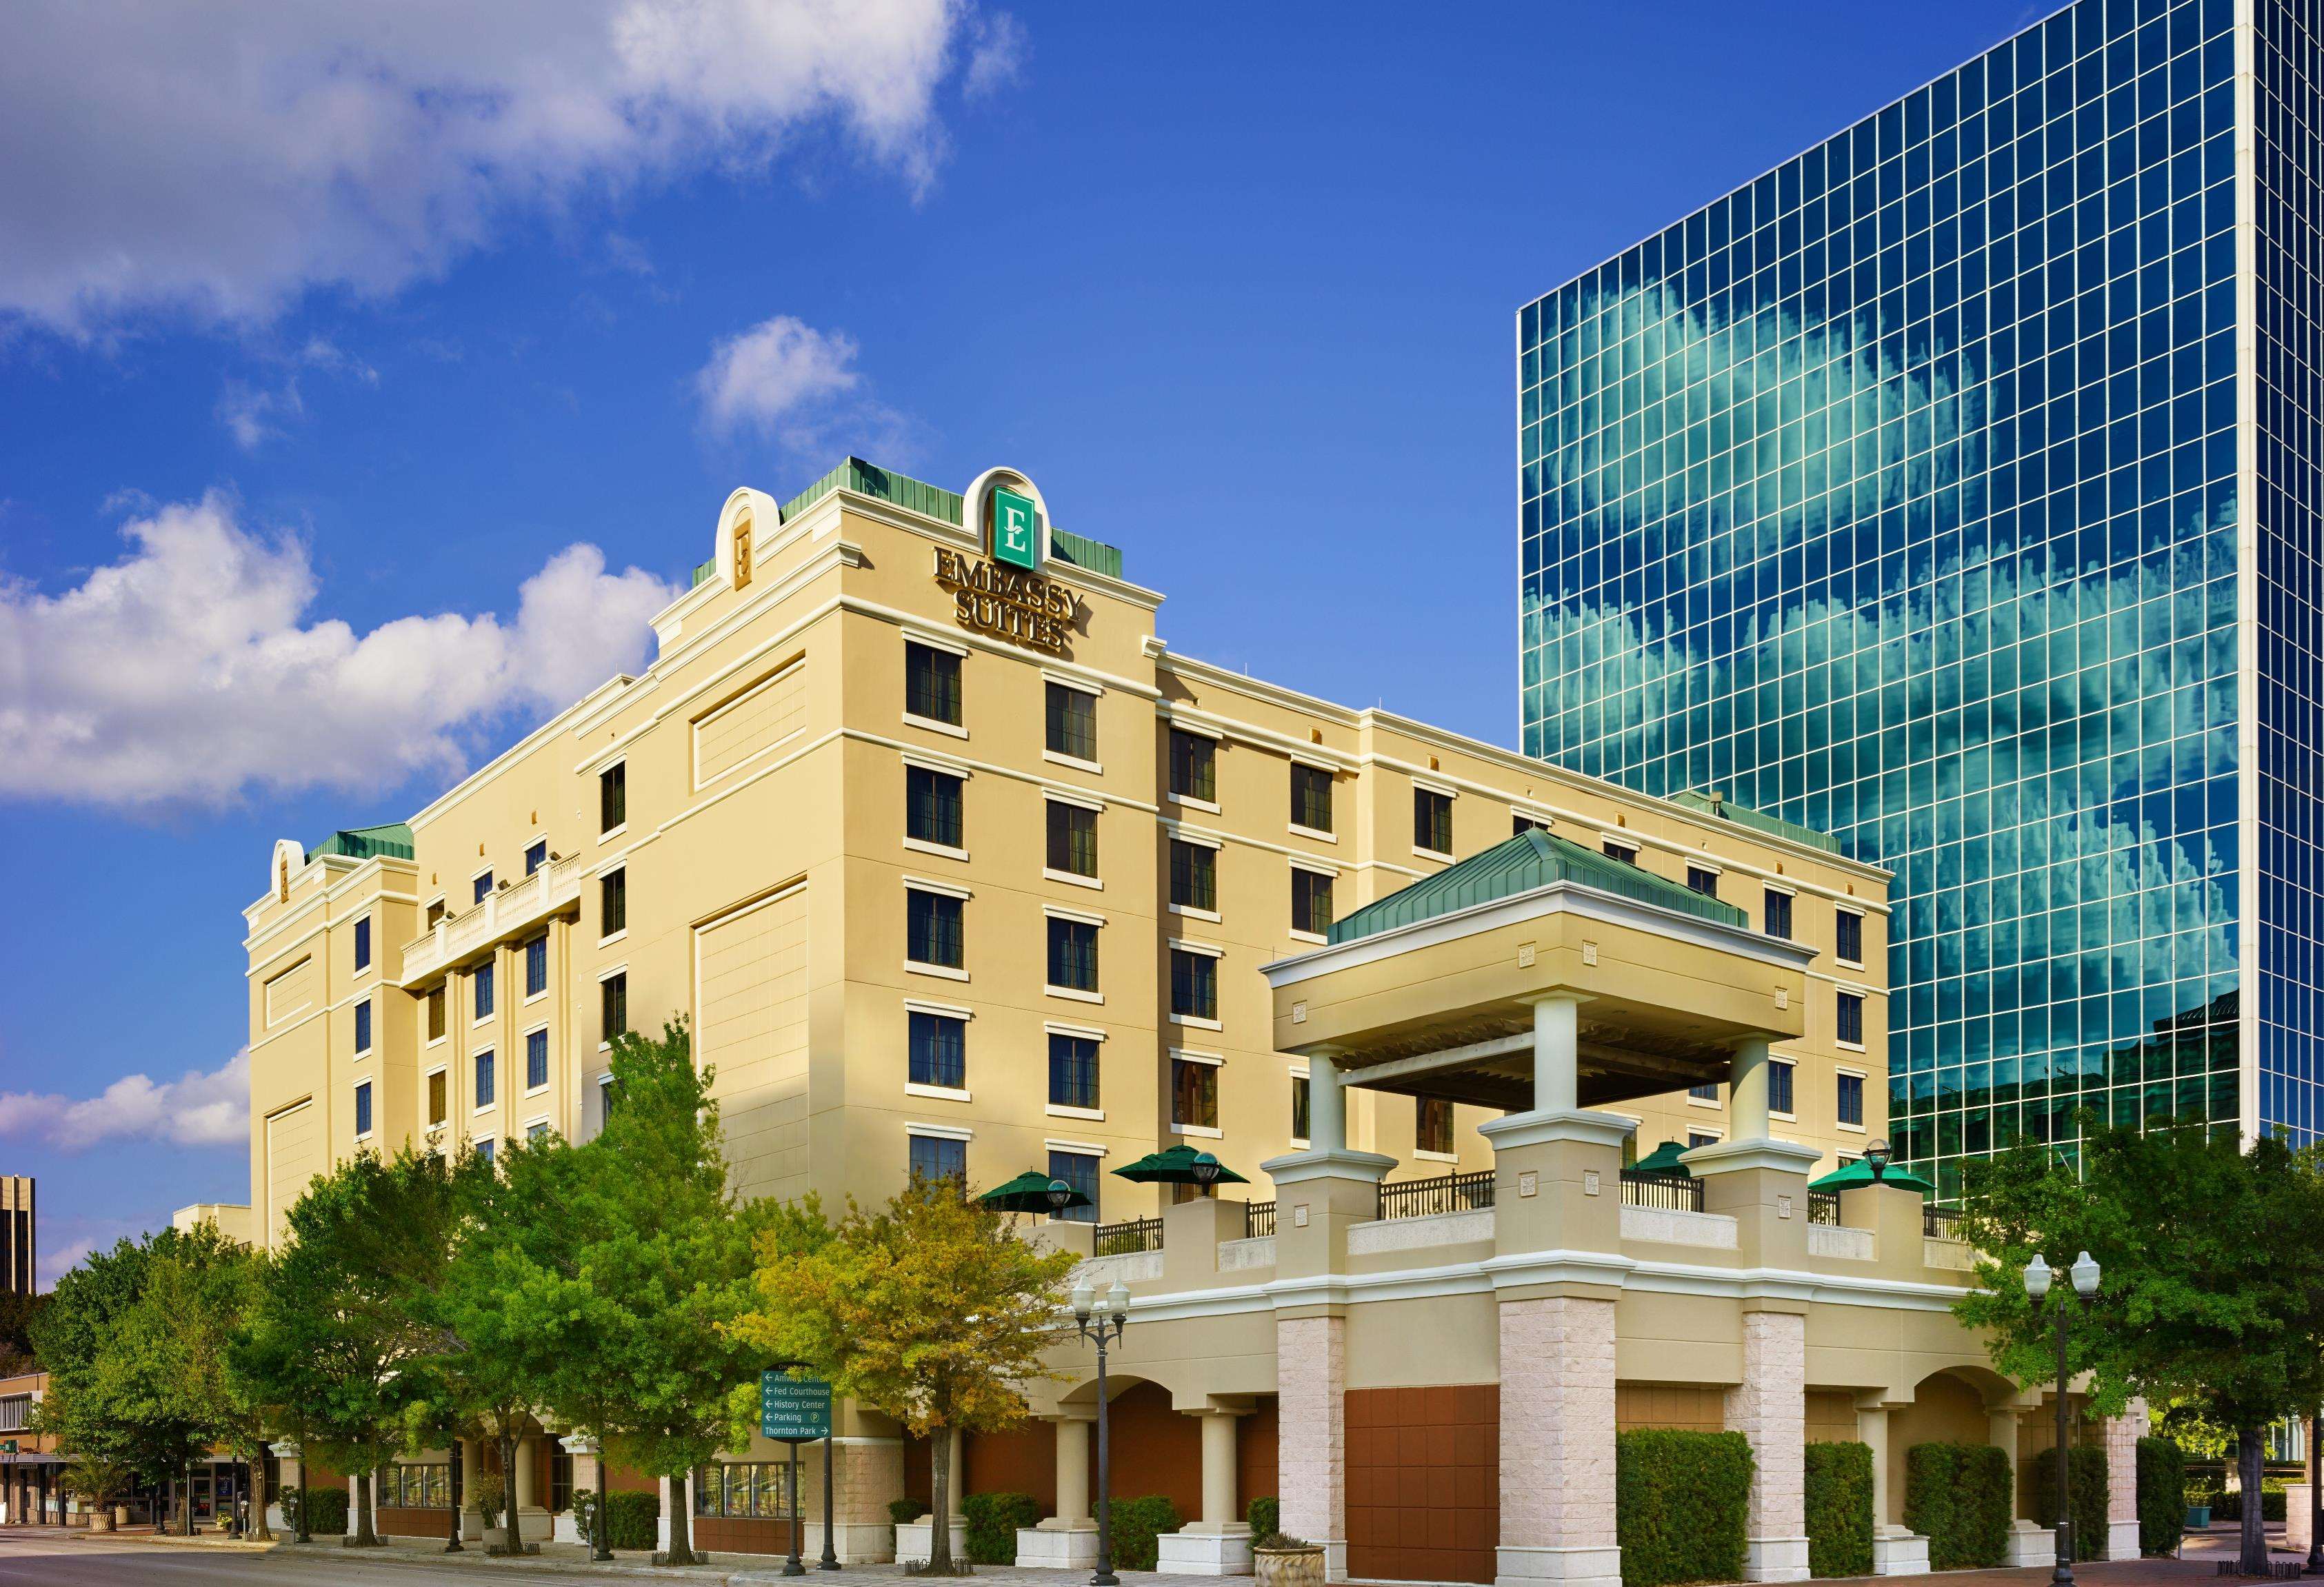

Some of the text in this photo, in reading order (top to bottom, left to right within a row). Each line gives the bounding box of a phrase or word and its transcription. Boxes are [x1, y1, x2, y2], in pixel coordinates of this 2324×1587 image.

[1005, 506, 1025, 552] E
[933, 546, 1084, 623] EMBASSY
[954, 589, 1065, 651] SUITES
[774, 1400, 799, 1410] History
[774, 1413, 801, 1423] Parking
